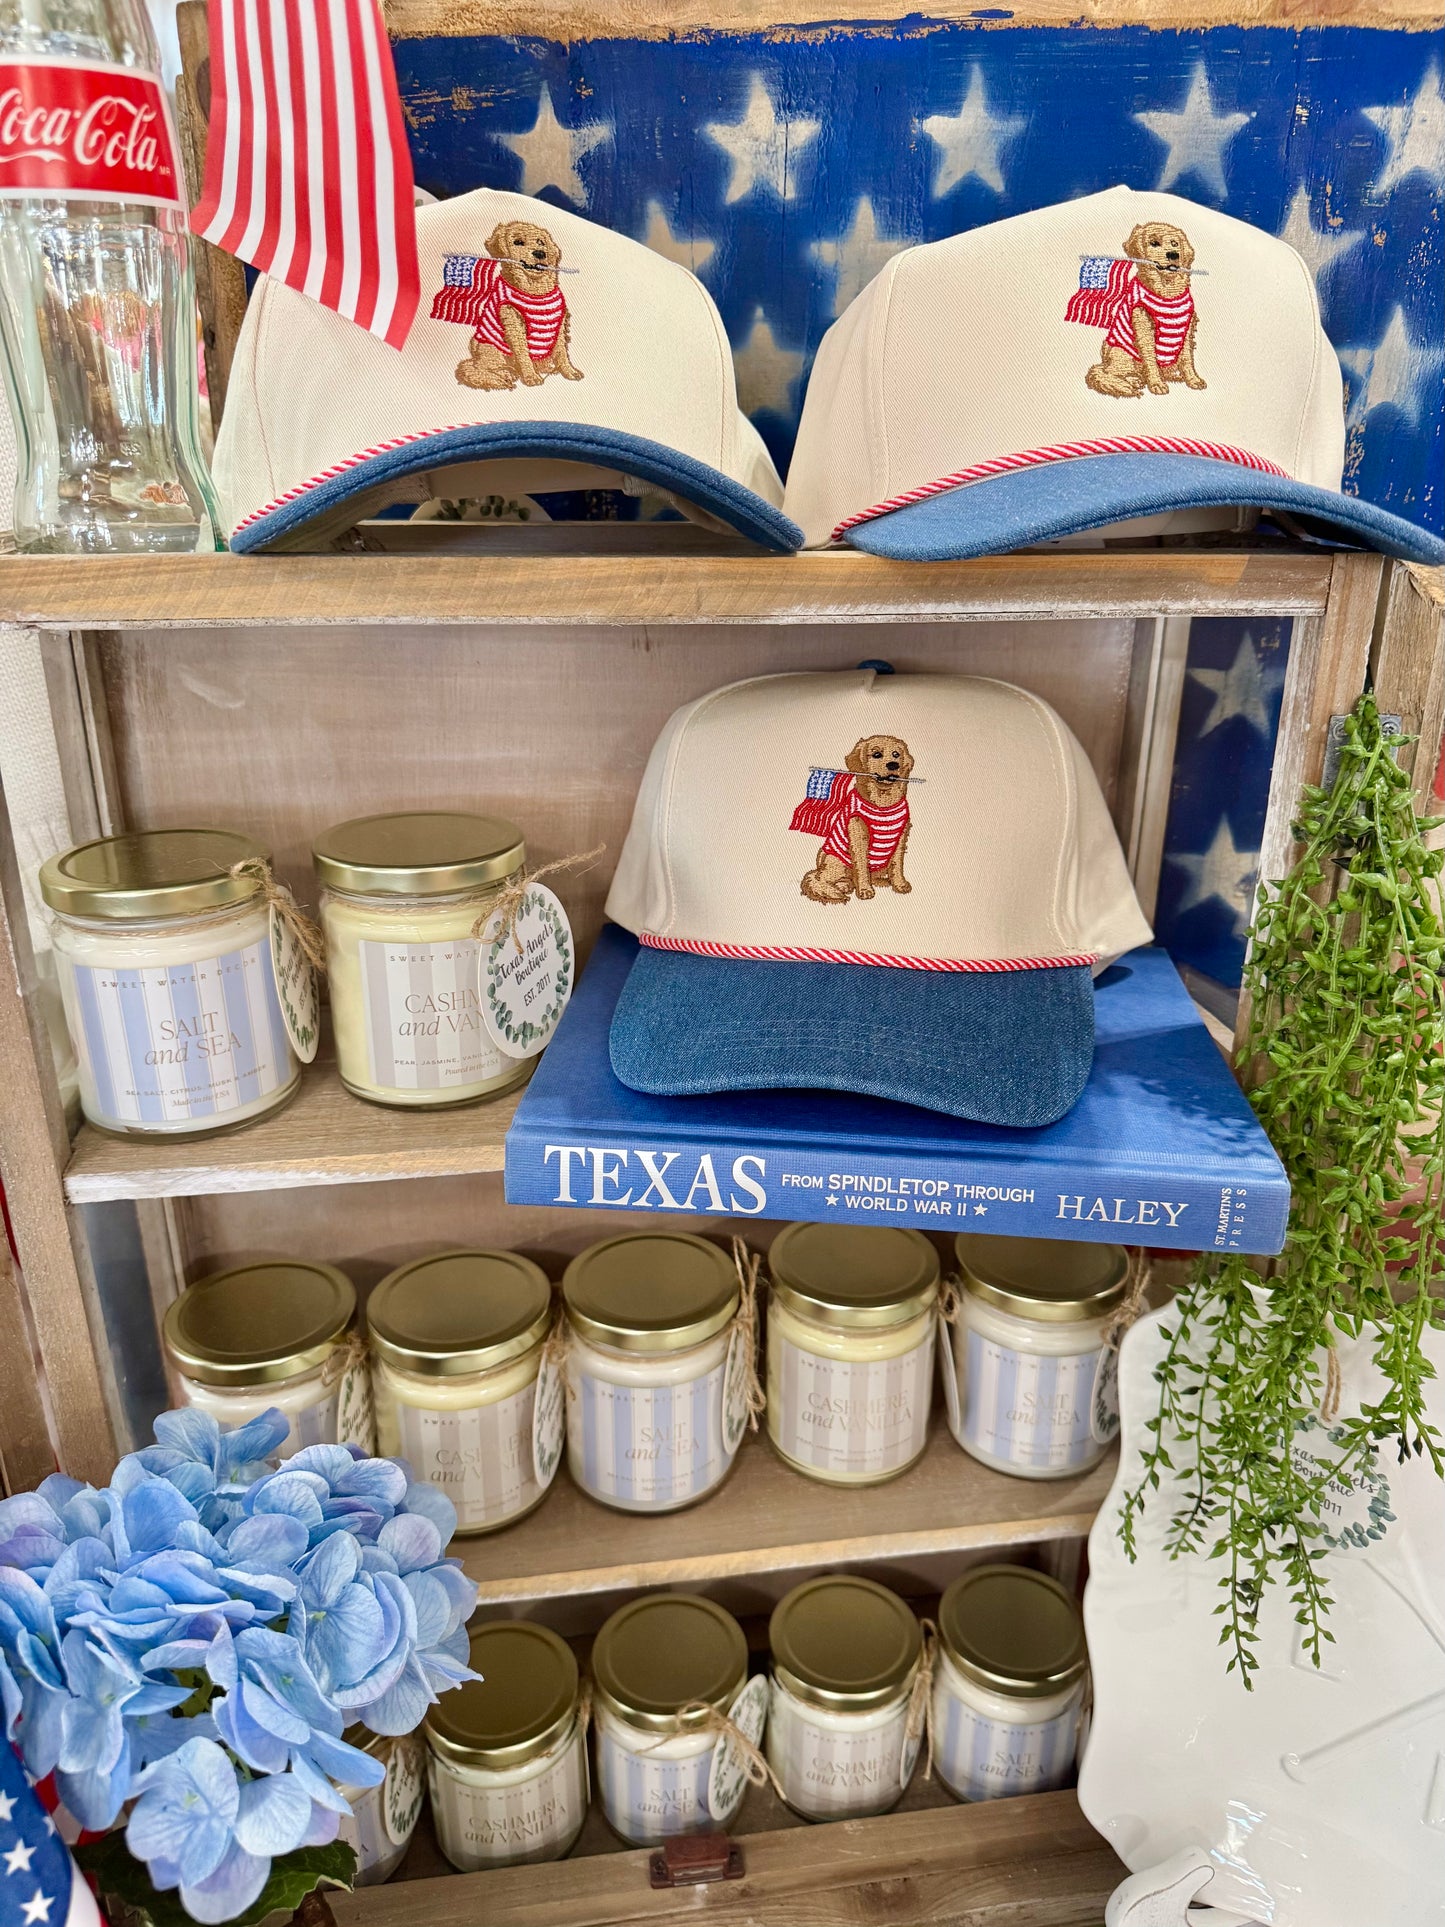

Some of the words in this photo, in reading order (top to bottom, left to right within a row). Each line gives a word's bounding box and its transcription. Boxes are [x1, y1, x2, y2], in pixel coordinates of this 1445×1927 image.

[444, 949, 478, 960] WATE
[500, 954, 524, 979] Texas
[526, 923, 554, 956] Angels
[101, 980, 146, 989] SWEET
[157, 973, 207, 987] WATER
[515, 948, 549, 986] Boutique
[405, 988, 480, 1014] CASHM
[523, 987, 537, 1007] EST.
[536, 972, 551, 995] 2011
[160, 1011, 218, 1041] SALT
[398, 1015, 441, 1036] and
[144, 1041, 189, 1066] and
[196, 1031, 242, 1060] SEA
[421, 1057, 459, 1066] JASMINE,
[544, 1144, 767, 1214] TEXAS
[781, 1174, 823, 1188] FROM
[828, 1174, 949, 1196] SPINDLETOP
[954, 1184, 1034, 1202] THROUGH
[844, 1194, 908, 1212] WORLD
[914, 1200, 951, 1215] WAR
[957, 1203, 967, 1216] II
[1055, 1194, 1189, 1227] HALEY
[1217, 1187, 1232, 1234] MARTIN'S
[1229, 1189, 1247, 1247] PRESS
[1214, 1235, 1226, 1246] ST.
[801, 1410, 834, 1430] and
[624, 1444, 661, 1461] and
[1280, 1435, 1315, 1463] Txas
[430, 1466, 466, 1483] and
[1293, 1458, 1354, 1497] Boutque
